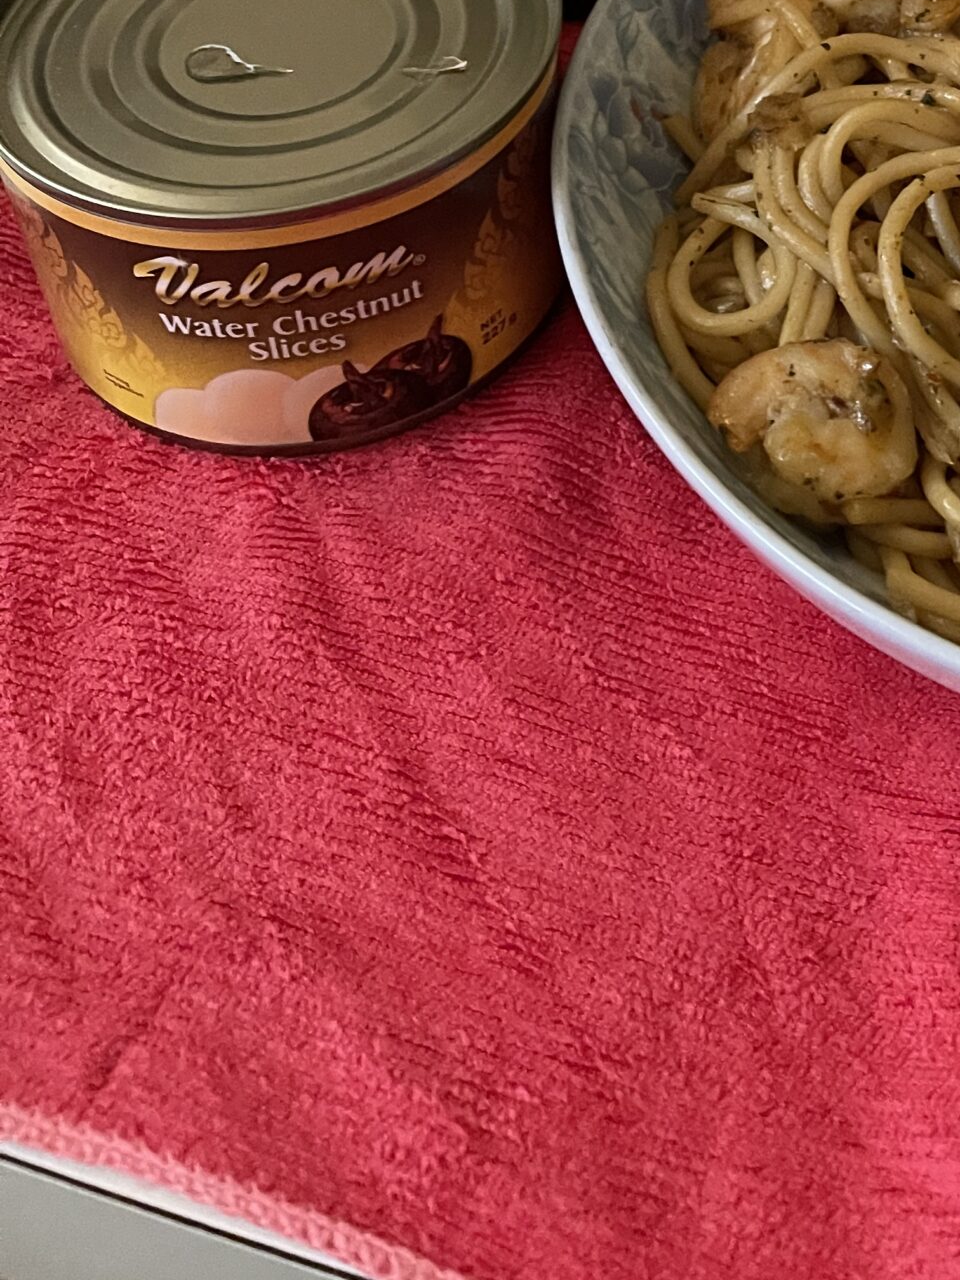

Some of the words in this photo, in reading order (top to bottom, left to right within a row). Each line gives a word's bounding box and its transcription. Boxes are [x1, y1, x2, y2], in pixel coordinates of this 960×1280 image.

[133, 245, 416, 308] Valcom
[158, 312, 256, 339] Water
[272, 279, 425, 337] Chestnut
[248, 330, 348, 362] Slices
